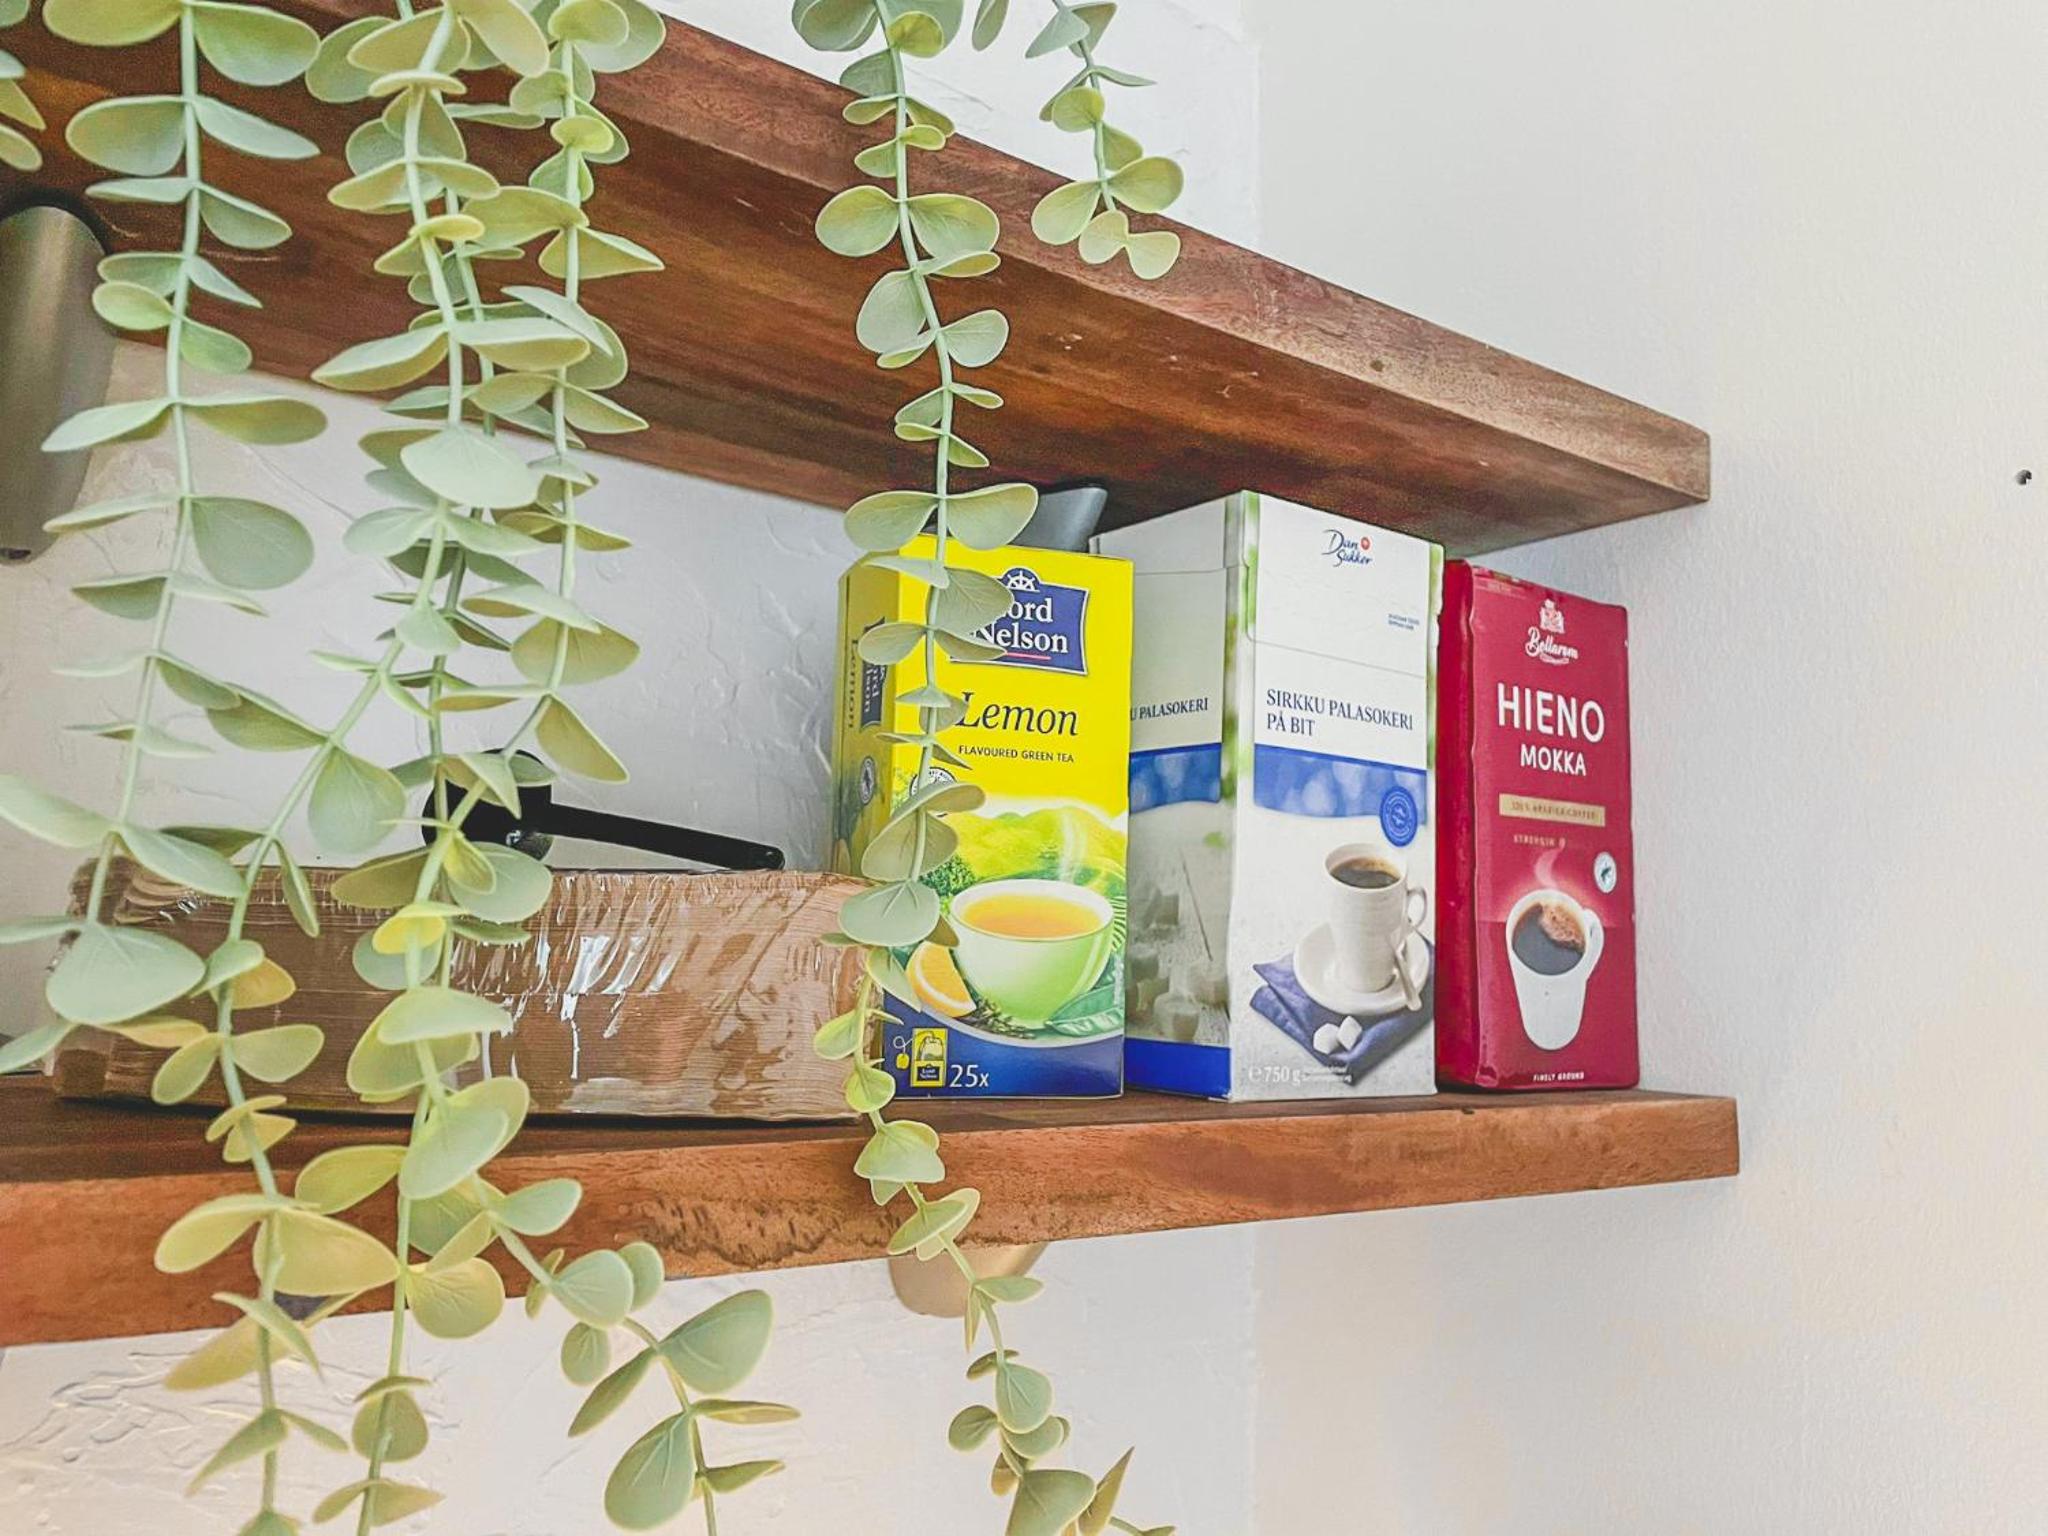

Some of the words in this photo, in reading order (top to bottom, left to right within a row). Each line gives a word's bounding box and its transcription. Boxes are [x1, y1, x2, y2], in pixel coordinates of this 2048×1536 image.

[1008, 597, 1053, 623] ord
[954, 691, 1078, 736] Lemon
[1139, 697, 1208, 720] PALASOKERI
[1266, 688, 1325, 714] SIRKKU
[1328, 699, 1413, 731] PALASOKERI
[1498, 683, 1605, 743] HIENO
[1267, 710, 1287, 732] PÅ
[1290, 716, 1316, 736] BIT
[959, 745, 1018, 759] FLAVOURED
[1021, 750, 1054, 761] GREEN
[1057, 753, 1074, 763] TEA
[1520, 743, 1587, 776] MOKKA
[949, 1064, 989, 1088] 25x
